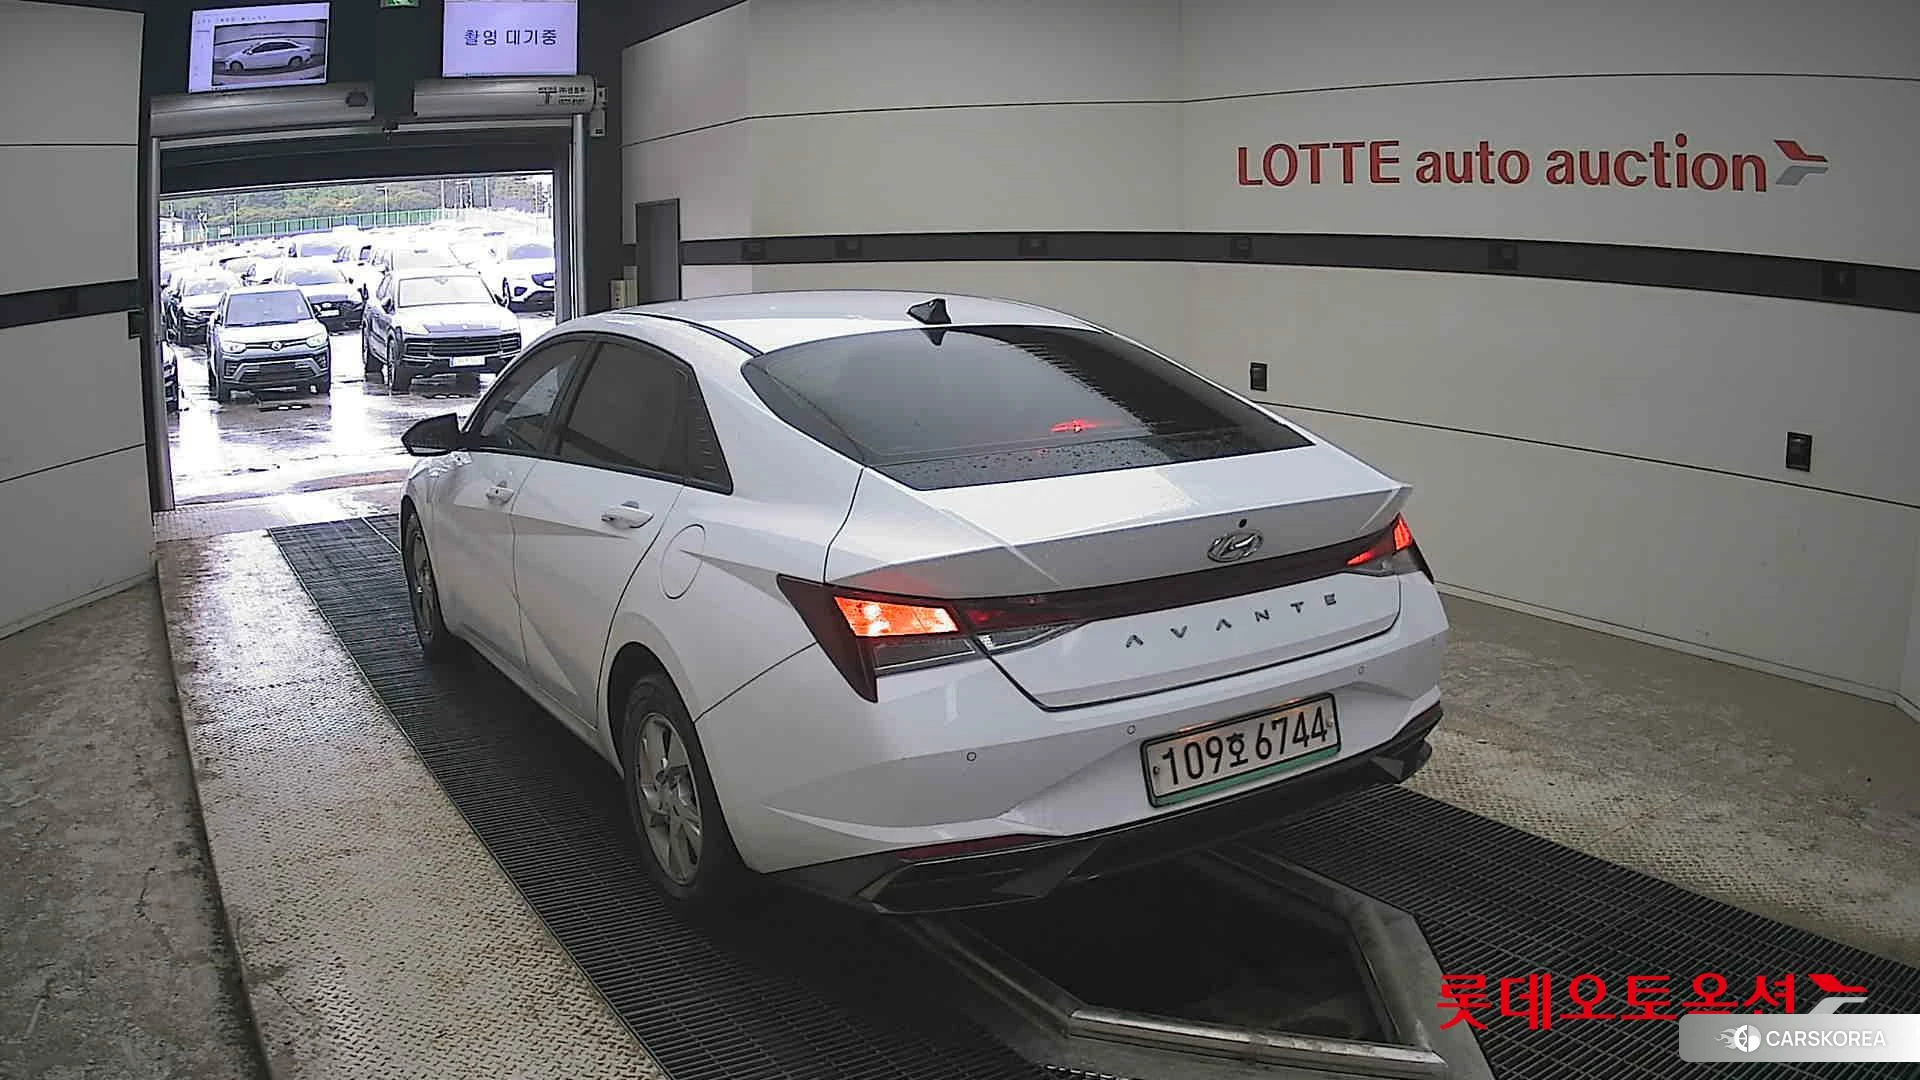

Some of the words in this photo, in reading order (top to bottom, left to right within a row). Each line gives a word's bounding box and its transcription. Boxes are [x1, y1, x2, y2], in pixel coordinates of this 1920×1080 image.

[505, 28, 557, 46] 대기중
[1237, 140, 1401, 187] LOTTE
[1415, 140, 1531, 185] auto
[1545, 132, 1767, 193] auction
[1125, 593, 1337, 648] AVANTE
